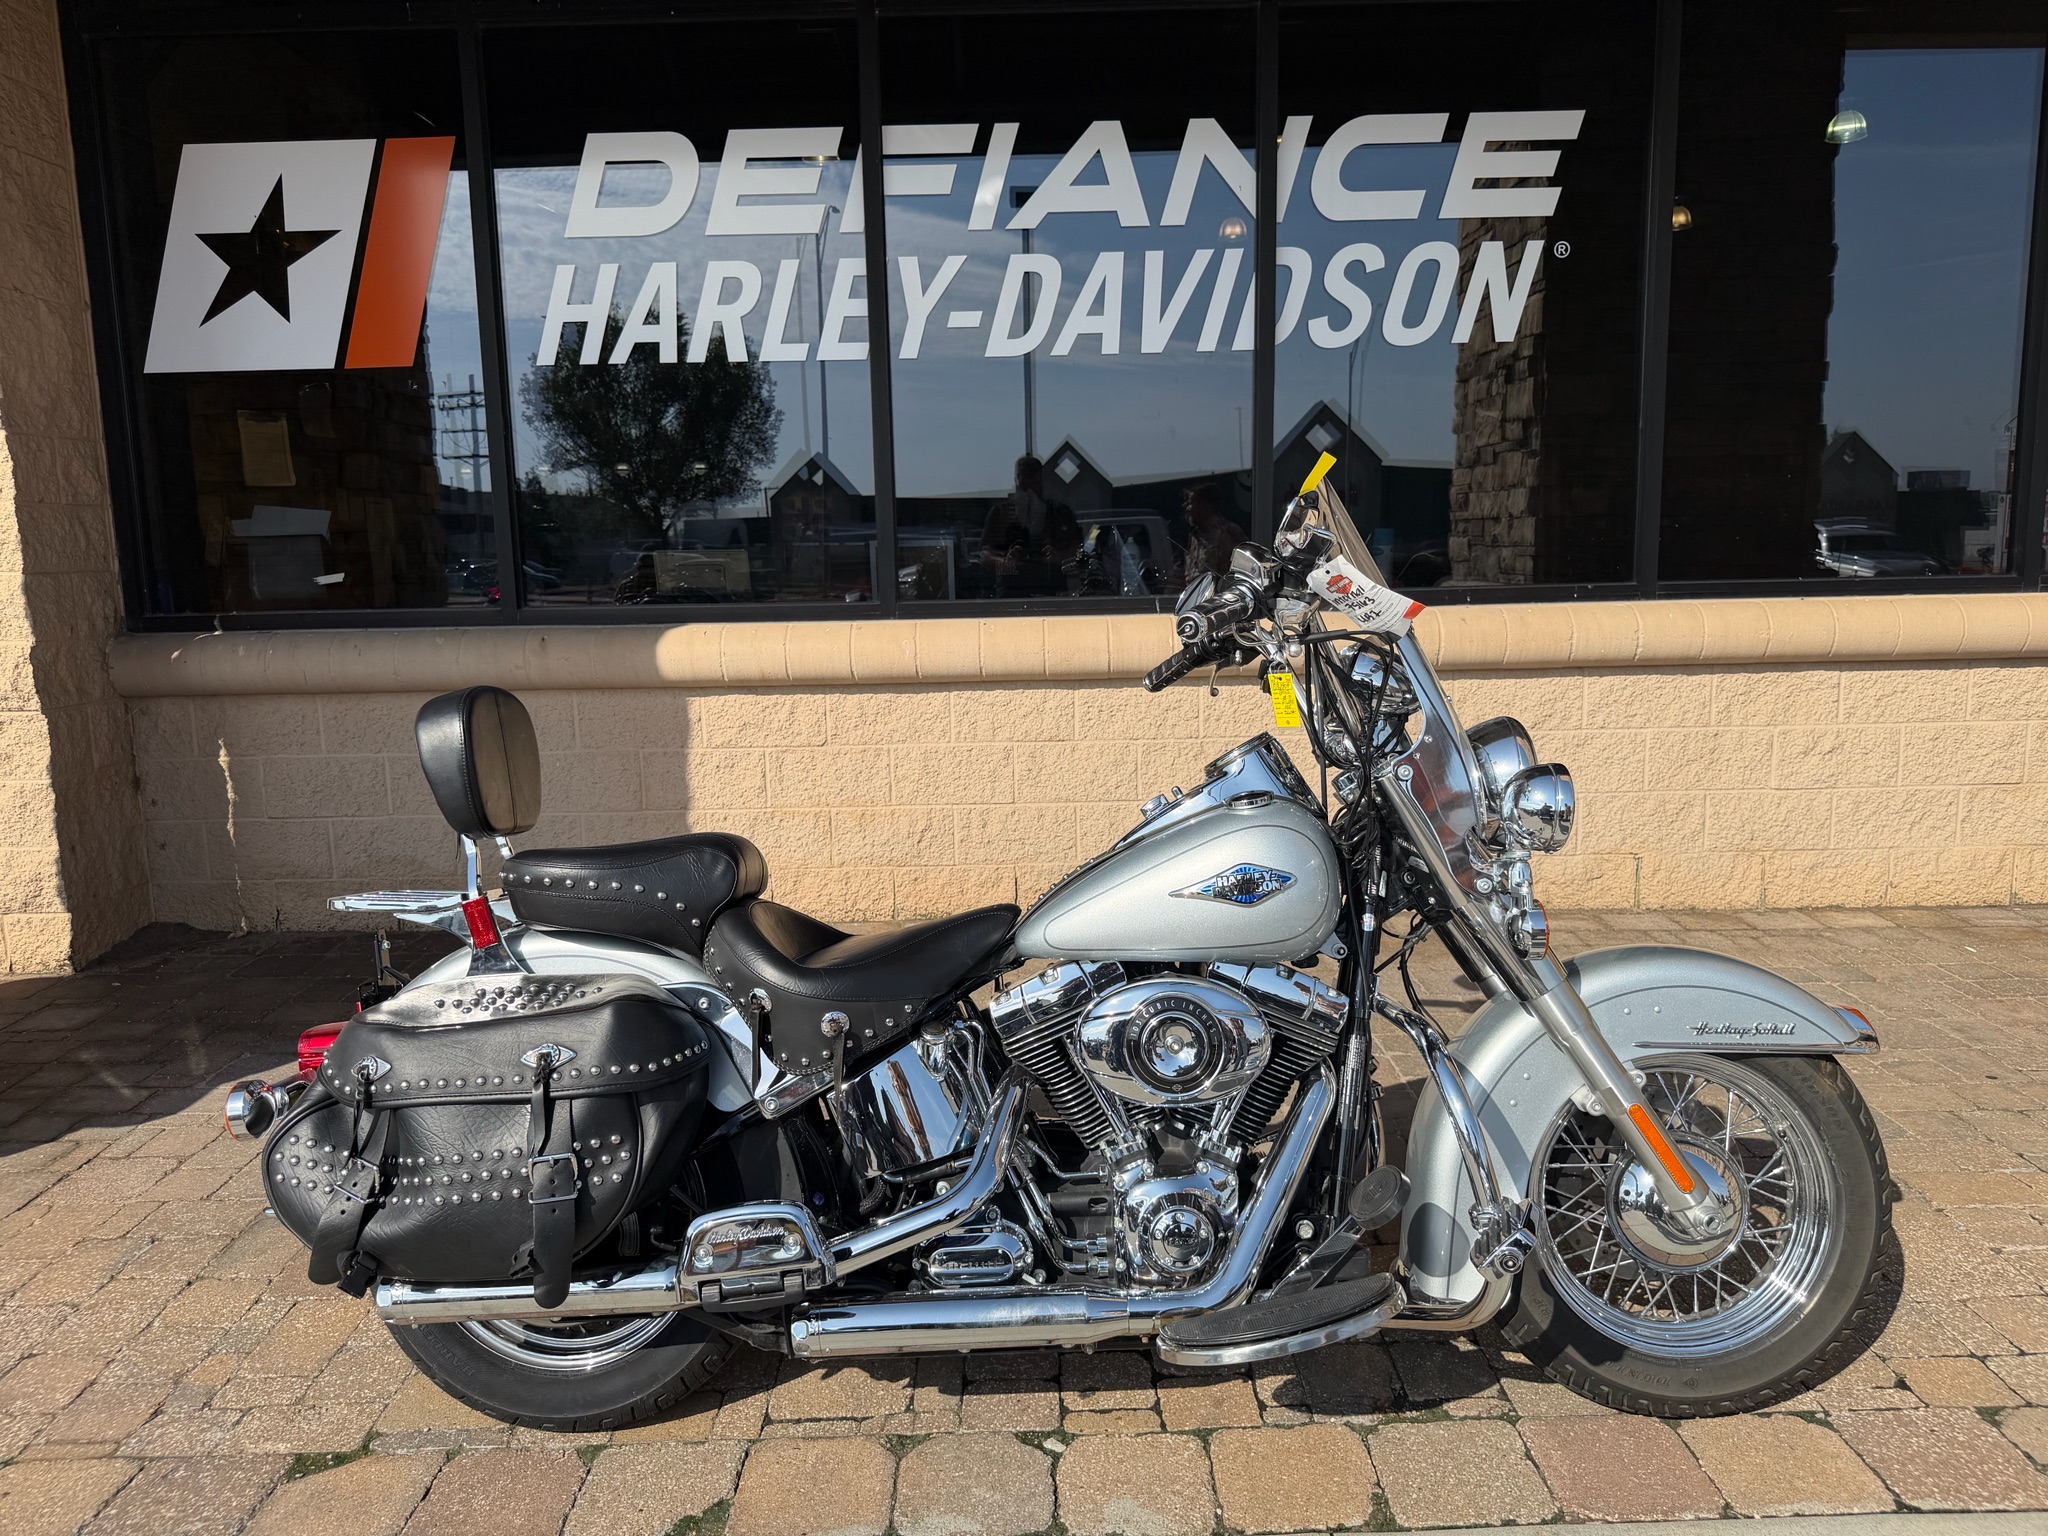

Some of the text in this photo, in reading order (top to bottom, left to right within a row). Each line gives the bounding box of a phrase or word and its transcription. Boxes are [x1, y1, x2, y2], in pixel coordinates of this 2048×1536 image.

[564, 110, 1586, 238] DEFIANCE
[1142, 1000, 1175, 1017] CUBIC
[1182, 1001, 1217, 1034] INCHES
